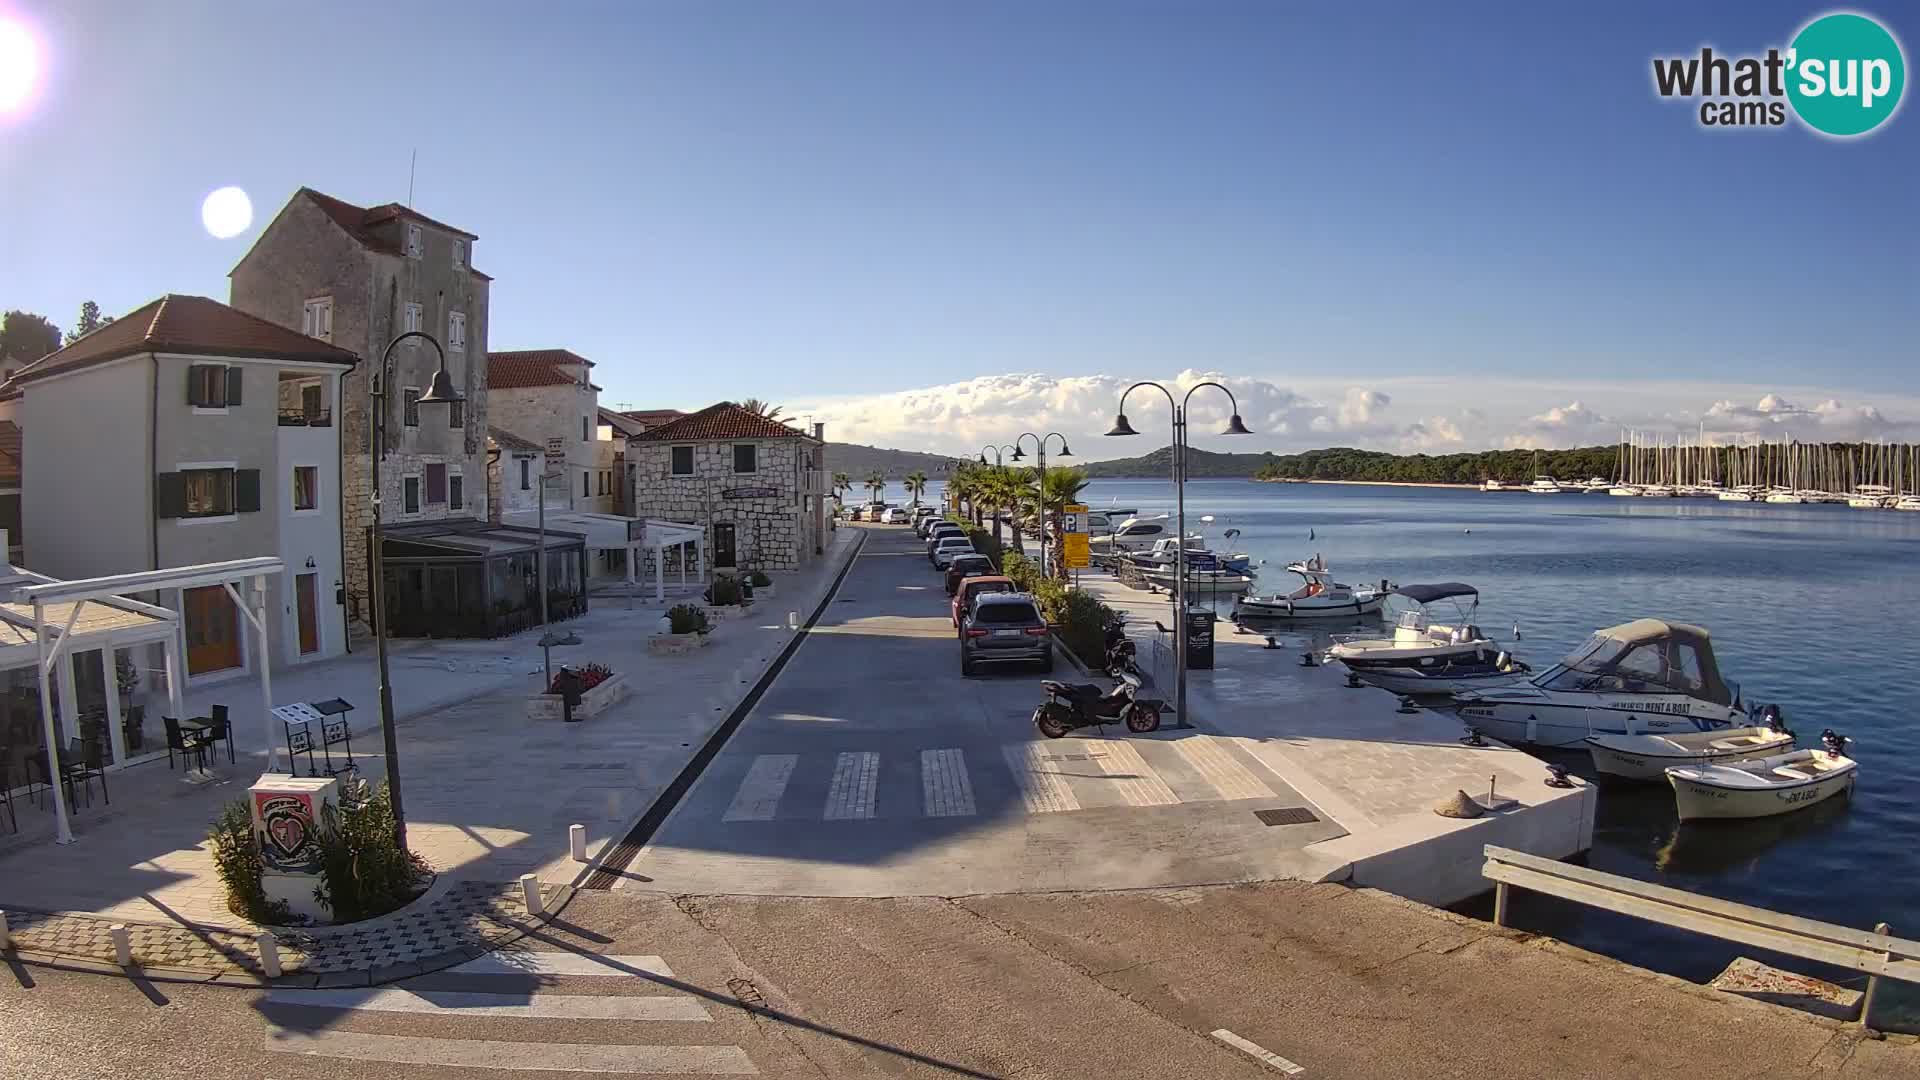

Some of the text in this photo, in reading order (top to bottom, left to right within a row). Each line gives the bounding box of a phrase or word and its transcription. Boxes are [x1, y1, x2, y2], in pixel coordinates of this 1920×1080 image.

[1065, 515, 1076, 531] P
[1645, 702, 1665, 713] RENT
[1665, 703, 1671, 713] A
[1672, 703, 1691, 714] BOAT
